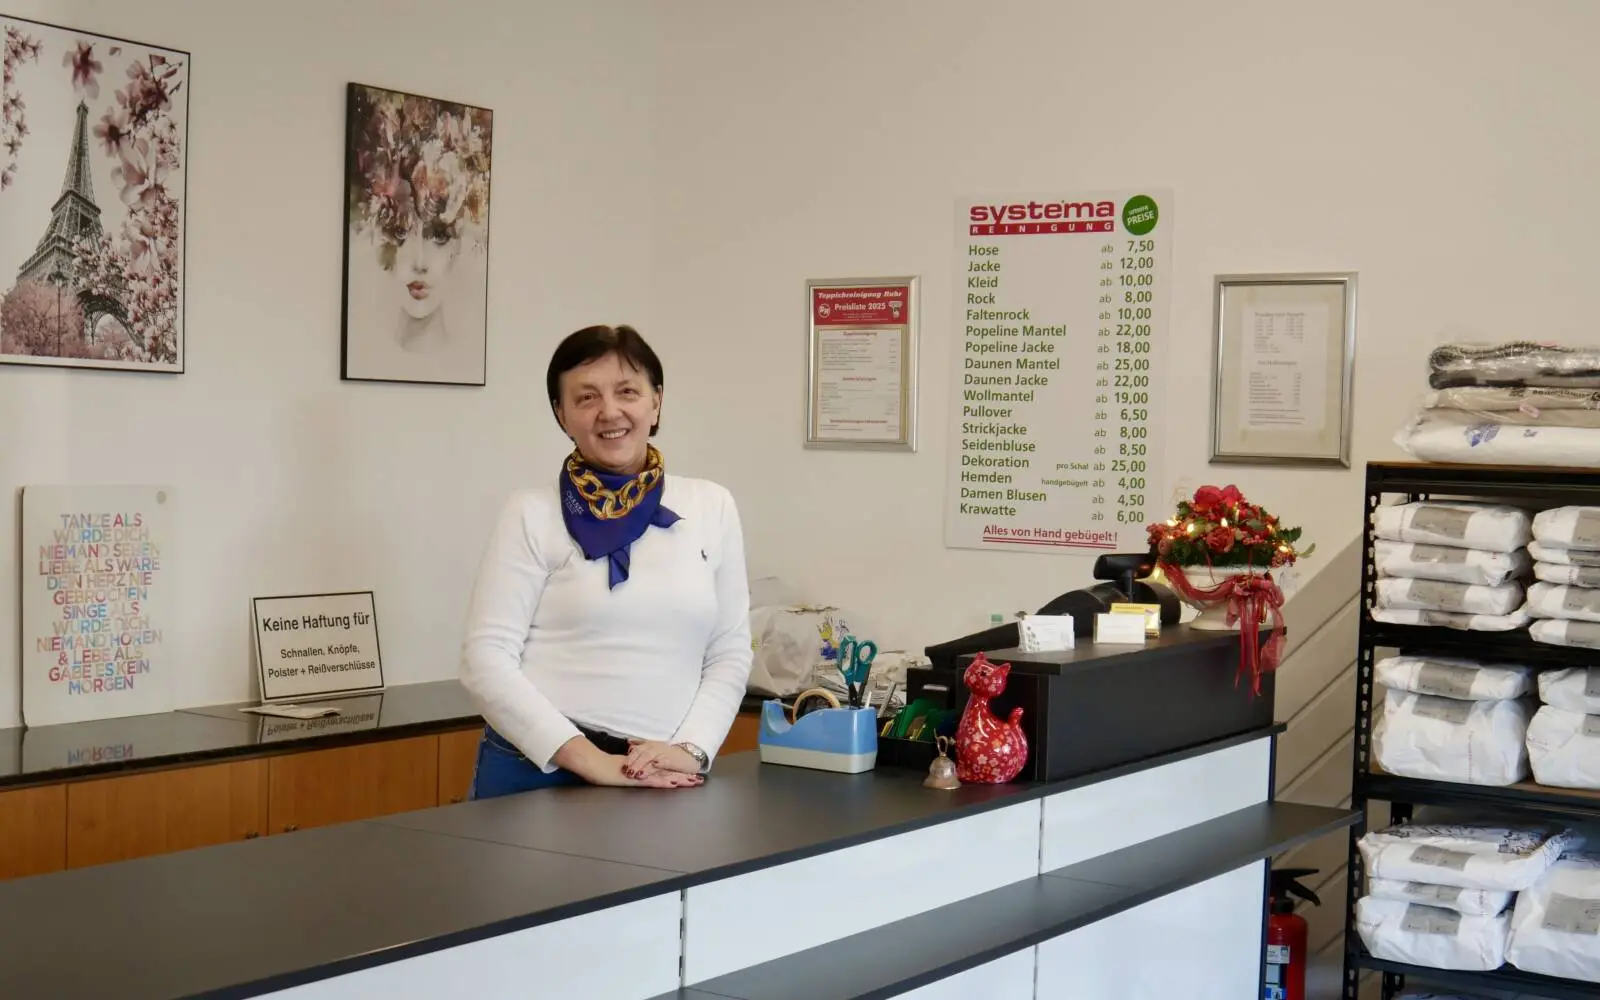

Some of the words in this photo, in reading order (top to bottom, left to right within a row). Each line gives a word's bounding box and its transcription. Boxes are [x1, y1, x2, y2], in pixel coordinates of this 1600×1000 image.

[970, 200, 1115, 224] systema
[1127, 211, 1154, 226] PREISE
[971, 223, 1112, 234] REINIGUNG
[968, 244, 999, 256] Hose
[1101, 244, 1113, 253] ab
[1128, 240, 1154, 253] 7,50
[968, 261, 1000, 272] Jacke
[1100, 261, 1112, 270] ab
[1120, 257, 1154, 270] 12,00
[968, 277, 998, 288] Kleid
[1100, 278, 1112, 286] ab
[1120, 274, 1153, 287] 10,00
[968, 293, 995, 304] Rock
[1099, 294, 1111, 303] ab
[1125, 291, 1152, 304] 8,00
[967, 309, 1029, 320] Faltenrock
[1099, 311, 1111, 320] ab
[1118, 308, 1152, 321] 10,00
[966, 326, 1018, 340] Popeline
[1022, 325, 1066, 336] Mantel
[1098, 327, 1110, 336] ab
[1116, 324, 1151, 338] 22,00
[965, 342, 1017, 356] Popeline
[1021, 341, 1054, 352] Jacke
[1097, 344, 1109, 353] ab
[1116, 341, 1150, 354] 18,00
[965, 358, 1012, 369] Daunen
[1016, 358, 1060, 370] Mantel
[1097, 361, 1109, 370] ab
[1114, 359, 1150, 372] 25,00
[964, 374, 1011, 386] Daunen
[1015, 374, 1048, 386] Jacke
[1096, 378, 1108, 387] ab
[1114, 375, 1148, 388] 22,00
[964, 390, 1034, 402] Wollmantel
[1096, 394, 1108, 404] ab
[1114, 392, 1148, 405] 19,00
[963, 406, 1012, 418] Pullover
[1095, 411, 1107, 420] ab
[1120, 409, 1147, 422] 6,50
[962, 423, 1027, 437] Strickjacke
[1094, 428, 1106, 437] ab
[1120, 426, 1147, 440] 8,00
[962, 439, 1036, 452] Seidenbluse
[1094, 446, 1106, 455] ab
[1119, 444, 1146, 457] 8,50
[962, 455, 1029, 468] Dekoration
[1094, 462, 1105, 471] ab
[1111, 460, 1146, 473] 25,00
[961, 471, 1012, 484] Hemden
[1093, 479, 1105, 488] ab
[1118, 477, 1145, 490] 4,00
[961, 488, 1002, 500] Damen
[1007, 489, 1046, 502] Blusen
[1092, 496, 1104, 505] ab
[1117, 494, 1144, 507] 4,50
[61, 514, 111, 528] TANZE
[113, 513, 143, 527] ALS
[960, 503, 1016, 516] Krawatte
[1092, 513, 1104, 522] ab
[1117, 511, 1144, 524] 6,00
[984, 525, 1008, 536] Alles
[1011, 527, 1030, 537] von
[1034, 527, 1062, 539] Hand
[40, 561, 80, 575] LIEBE
[84, 559, 114, 573] ALS
[47, 575, 82, 590] DEIN
[87, 574, 125, 588] HERZ
[130, 572, 152, 586] NIE
[63, 604, 107, 620] SINGE
[263, 618, 299, 632] Keine
[302, 614, 350, 629] Haftung
[353, 612, 370, 625] für
[58, 652, 68, 665] &
[73, 648, 111, 664] LEBE
[114, 646, 143, 661] ALS
[280, 647, 325, 659] Schnallen,
[328, 645, 360, 656] Knöpfe,
[95, 663, 114, 677] ES
[268, 667, 298, 678] Polster
[308, 660, 375, 675] Reißverschlüsse
[68, 676, 133, 695] MORGEN
